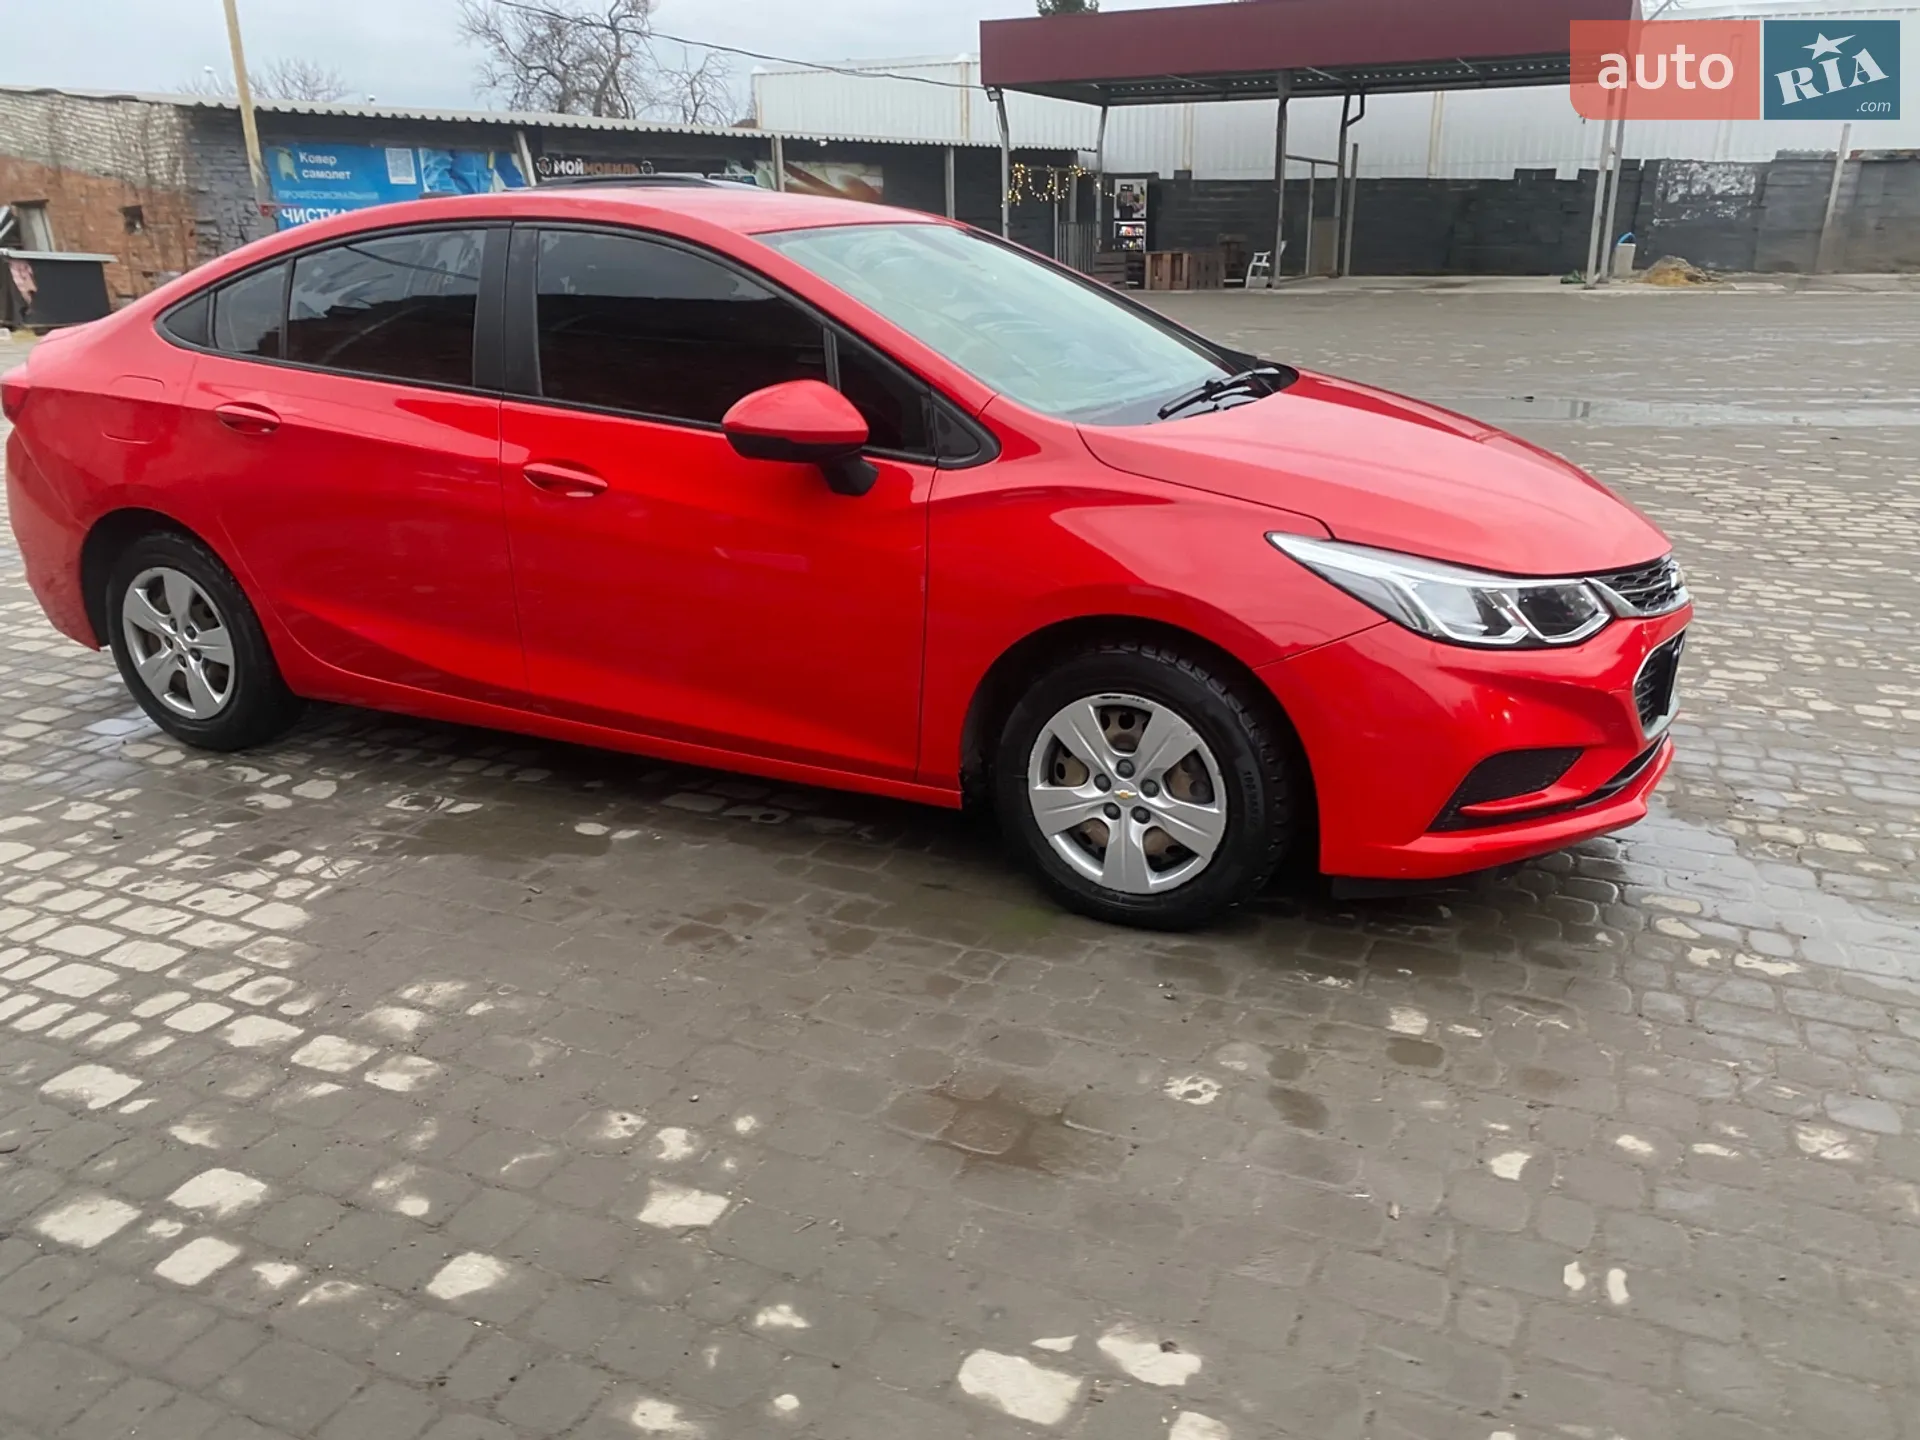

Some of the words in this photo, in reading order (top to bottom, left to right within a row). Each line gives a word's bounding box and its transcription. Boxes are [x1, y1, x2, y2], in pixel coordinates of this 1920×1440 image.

[299, 151, 337, 167] Ковер
[302, 169, 351, 180] самолет
[281, 207, 347, 224] ЧИСТК
